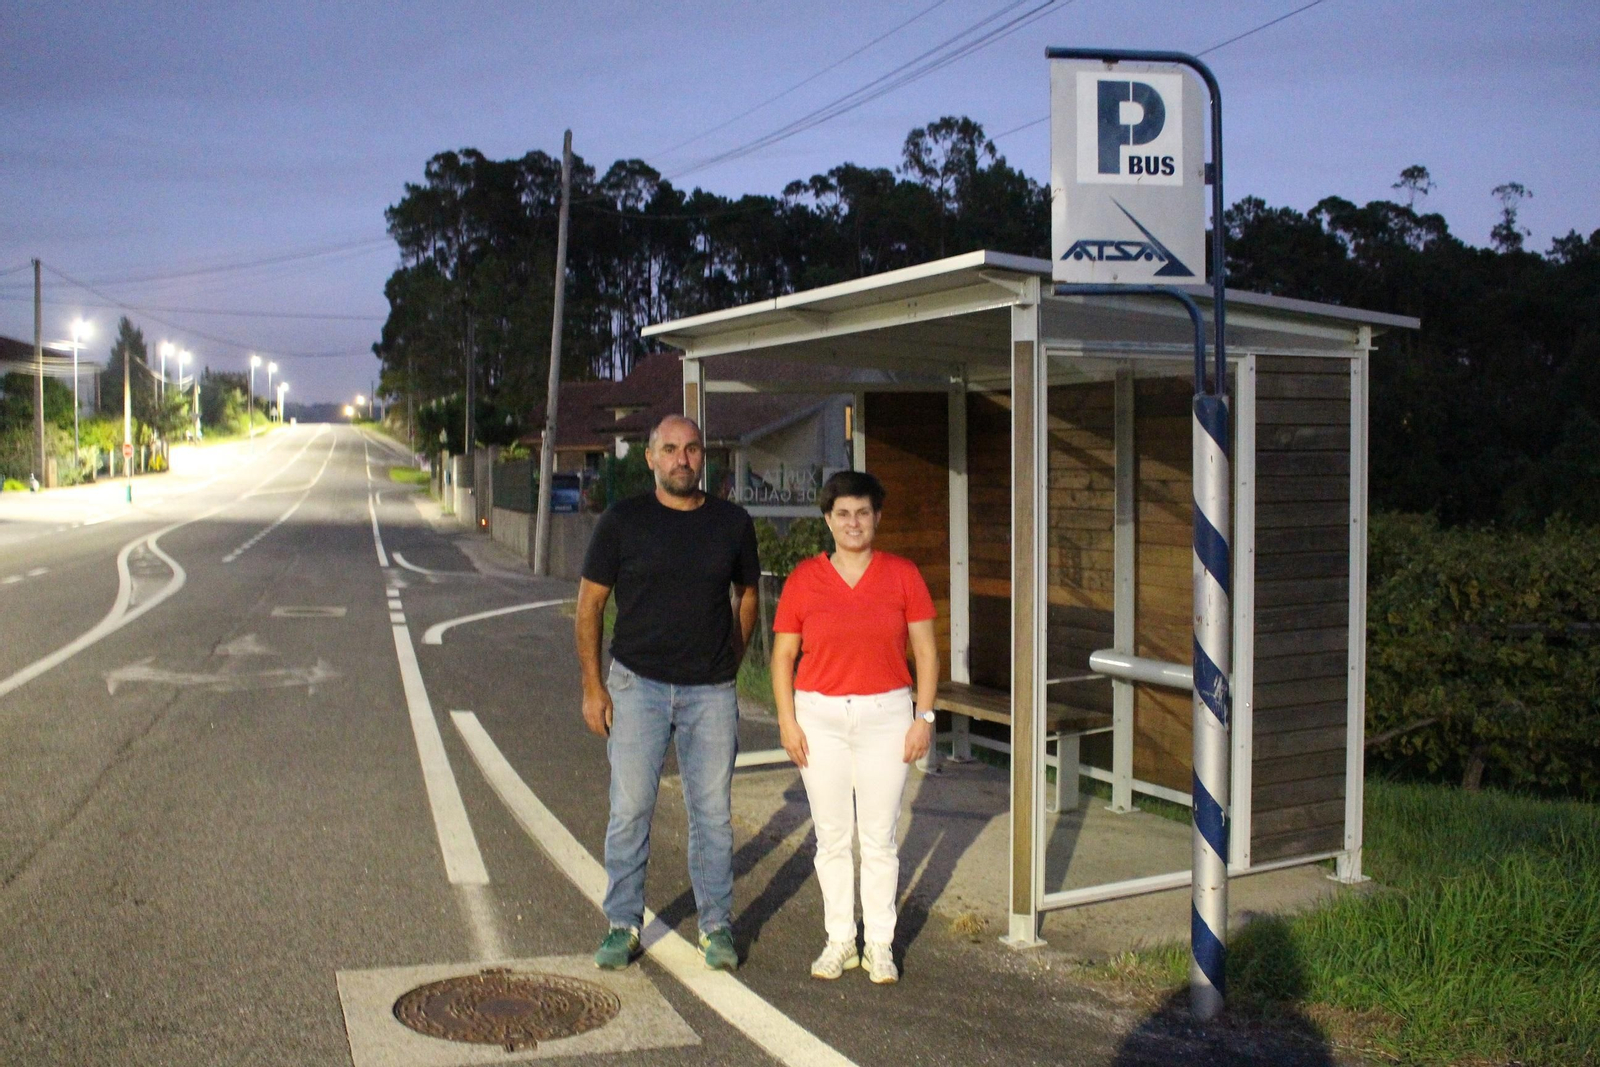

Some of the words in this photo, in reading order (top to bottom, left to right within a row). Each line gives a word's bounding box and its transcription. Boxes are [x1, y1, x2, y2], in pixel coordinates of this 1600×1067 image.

[1097, 79, 1166, 174] P
[1128, 156, 1175, 176] BUS
[1060, 239, 1167, 262] ATSA
